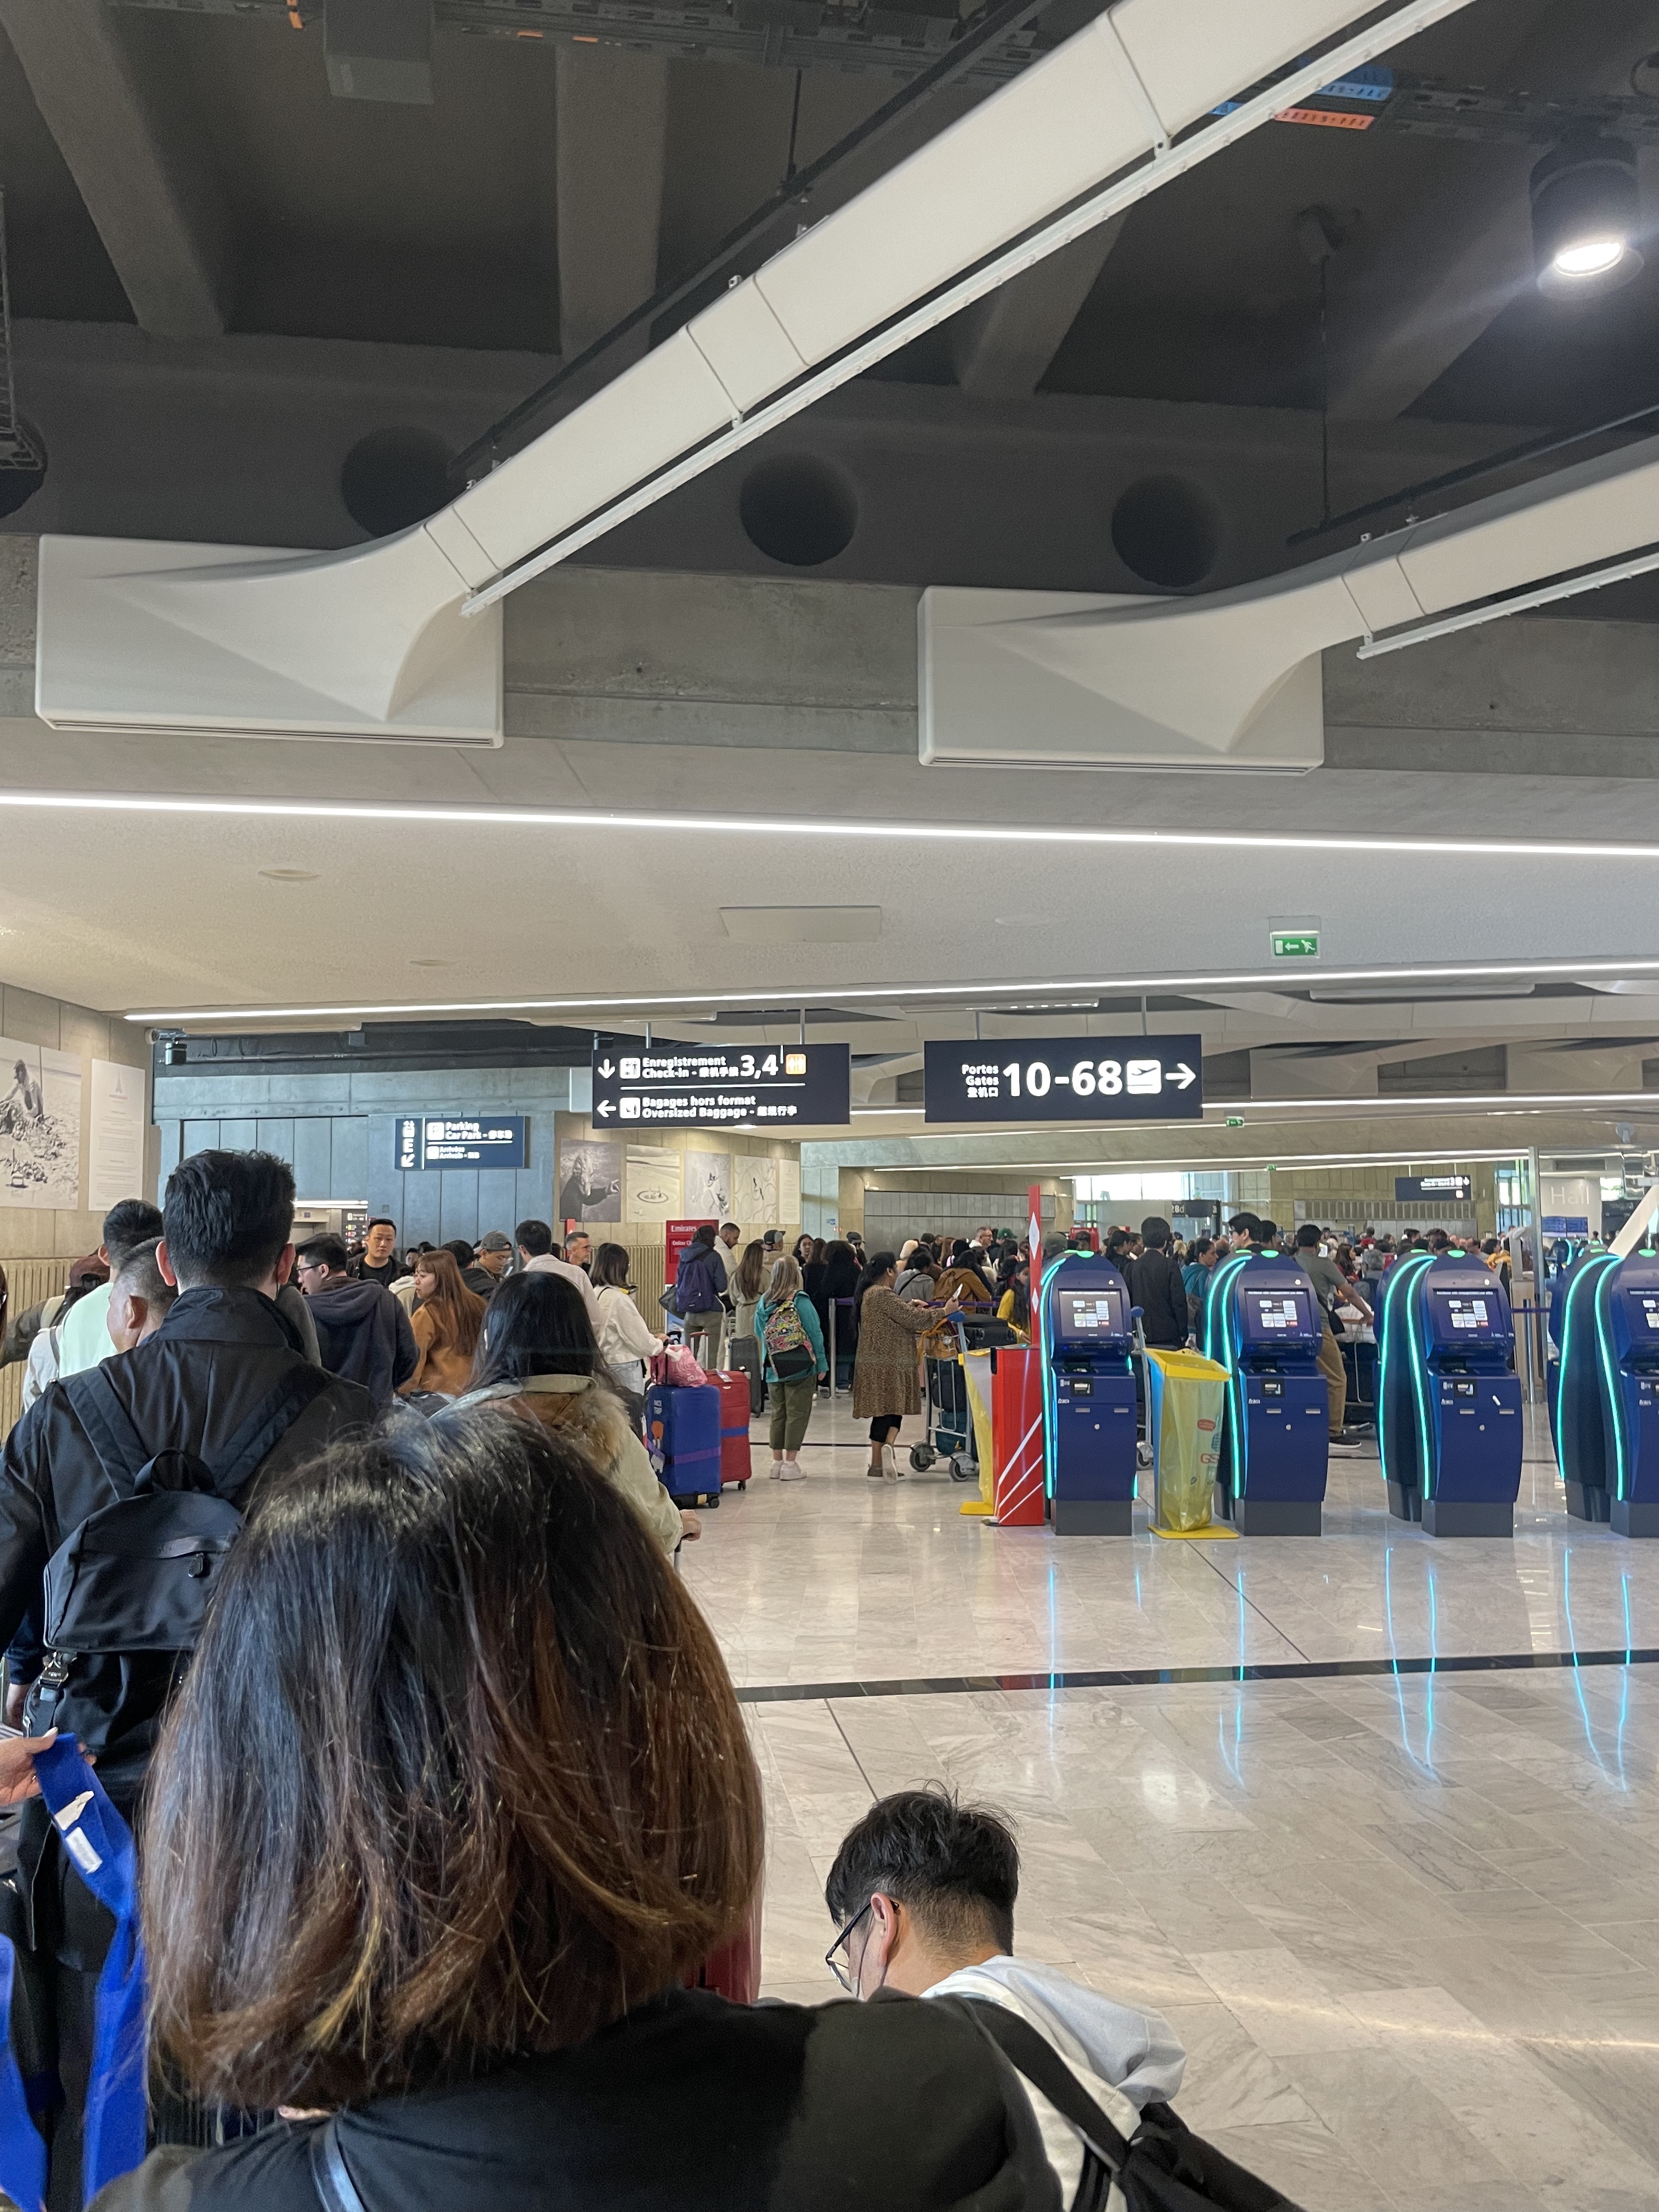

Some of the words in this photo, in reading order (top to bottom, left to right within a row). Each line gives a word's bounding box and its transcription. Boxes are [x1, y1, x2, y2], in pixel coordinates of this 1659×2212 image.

[643, 1056, 726, 1068] Enregistrement
[741, 1054, 778, 1079] 3,4
[642, 1067, 689, 1078] Check-in
[962, 1064, 998, 1074] Portes
[966, 1075, 999, 1086] Gates
[1003, 1060, 1122, 1096] 10-68
[642, 1097, 688, 1109] Bagages
[691, 1096, 715, 1106] hors
[718, 1095, 756, 1105] format
[642, 1107, 696, 1118] Oversized
[699, 1107, 747, 1119] Baggage
[445, 1121, 479, 1132] Parking
[445, 1131, 461, 1140] Car
[461, 1131, 482, 1139] Park
[1551, 1186, 1589, 1205] Hall
